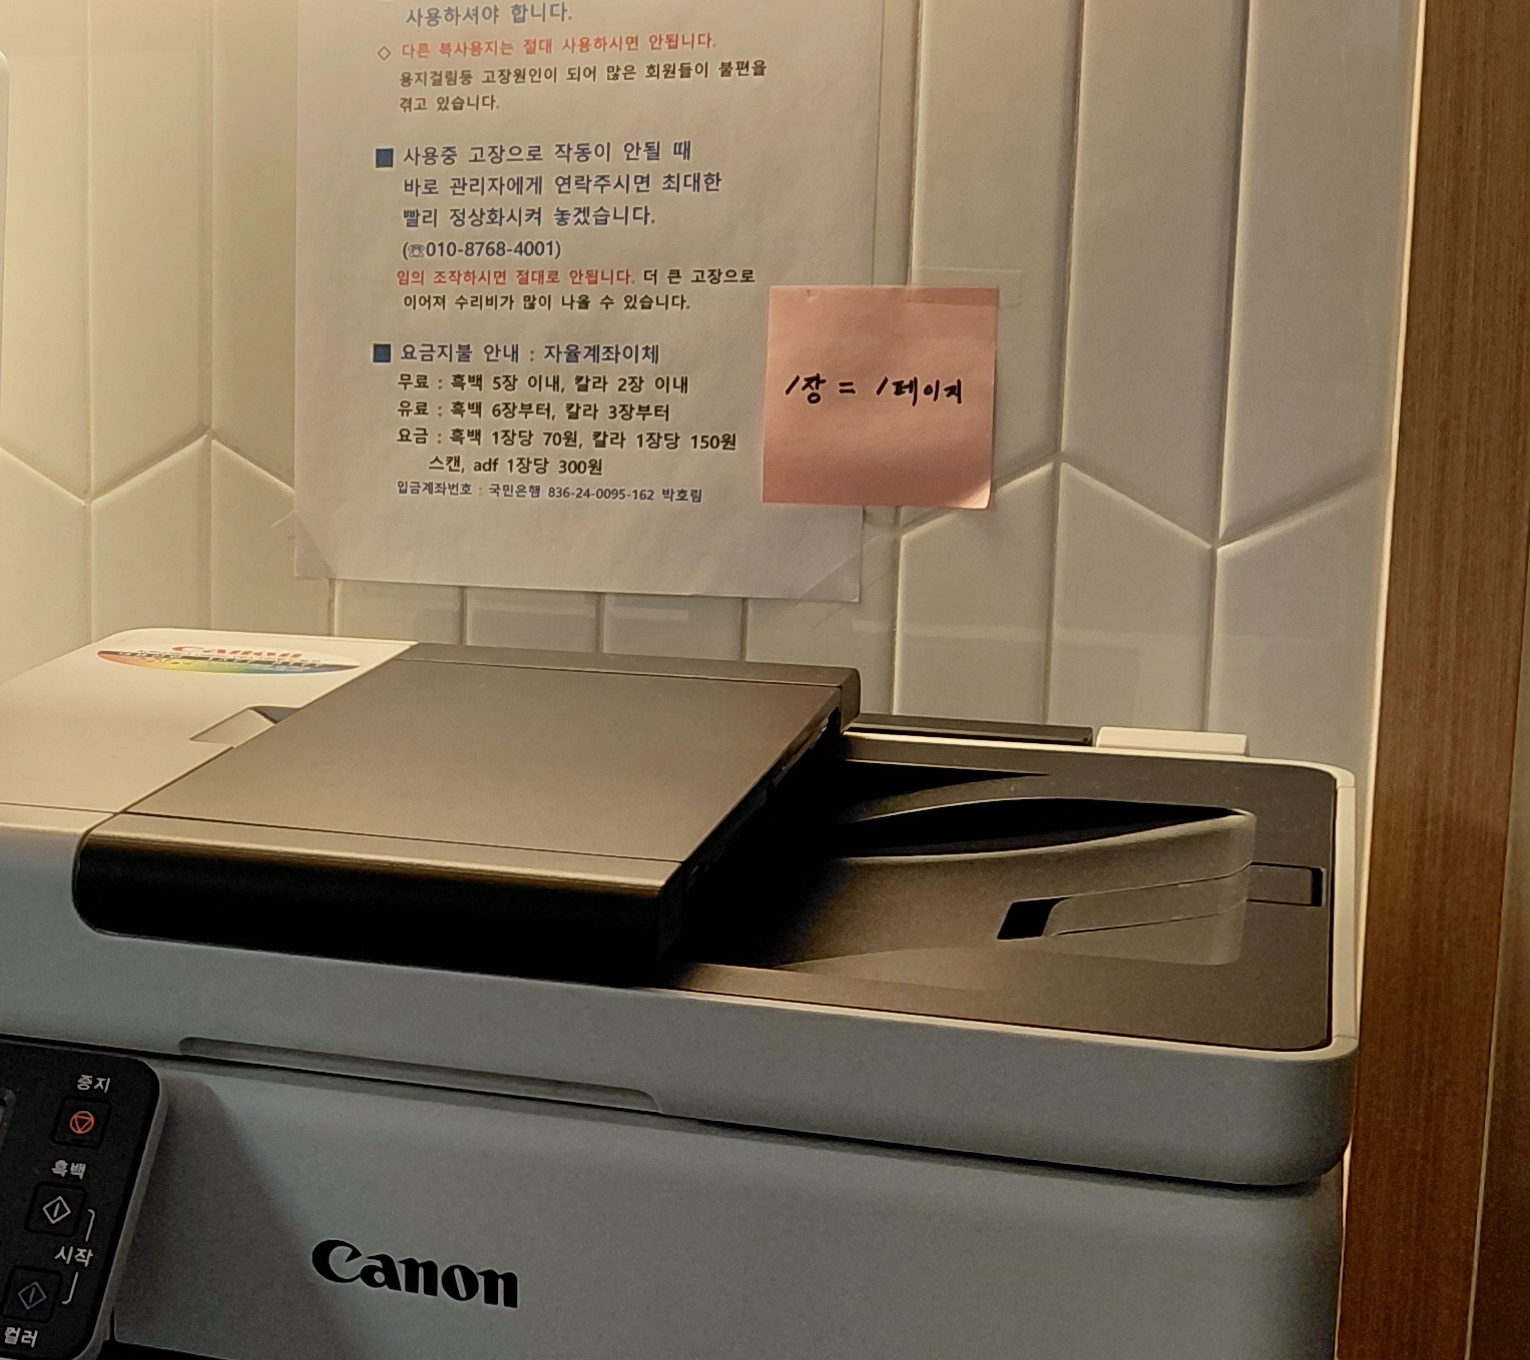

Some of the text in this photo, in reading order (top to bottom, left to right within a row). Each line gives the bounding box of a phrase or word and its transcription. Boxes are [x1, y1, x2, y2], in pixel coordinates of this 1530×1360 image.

[405, 0, 573, 27] 사용하셔야 합니다.
[401, 32, 717, 59] 다른 복사용지는 절대 사용하시면 안됩니다.
[399, 59, 767, 88] 용지걸림등 고장원인이 되어 많은 회원들이 불편을
[399, 93, 500, 113] 겪고 있습니다.
[403, 140, 692, 166] 사용중 고장으로 작동이 안될 때
[404, 172, 722, 197] 바로 관리자에게 연락주시면 최대한
[403, 205, 657, 229] 빨리 정상화시켜 놓겠습니다.
[397, 268, 755, 286] 임의 조작하시면 절대로 안됩니다. 더 큰 고장으로
[403, 293, 691, 311] 이어져 수리비가 많이 나올 수 있습니다.
[400, 342, 659, 365] 요금지불 안내 자율계좌이체
[398, 372, 689, 395] 무료 흑백 5장 이내, 칼라 2장 이내
[398, 400, 670, 423] 유료 흑백 6장부터, 칼라 3장부터
[397, 426, 736, 452] 요금 흑백 1장당 70원, 칼라 1장당 150원
[428, 454, 603, 477] 스캔, adf 1장당 300원
[397, 480, 473, 498] 입금계좌번호
[489, 481, 541, 500] 국민은행
[548, 484, 655, 503] 836-24-0095-162
[76, 1074, 111, 1094] 중지
[52, 1159, 87, 1180] 흑백
[54, 1245, 94, 1268] 시작
[312, 1240, 518, 1308] Canon
[3, 1326, 39, 1349] 컬러
